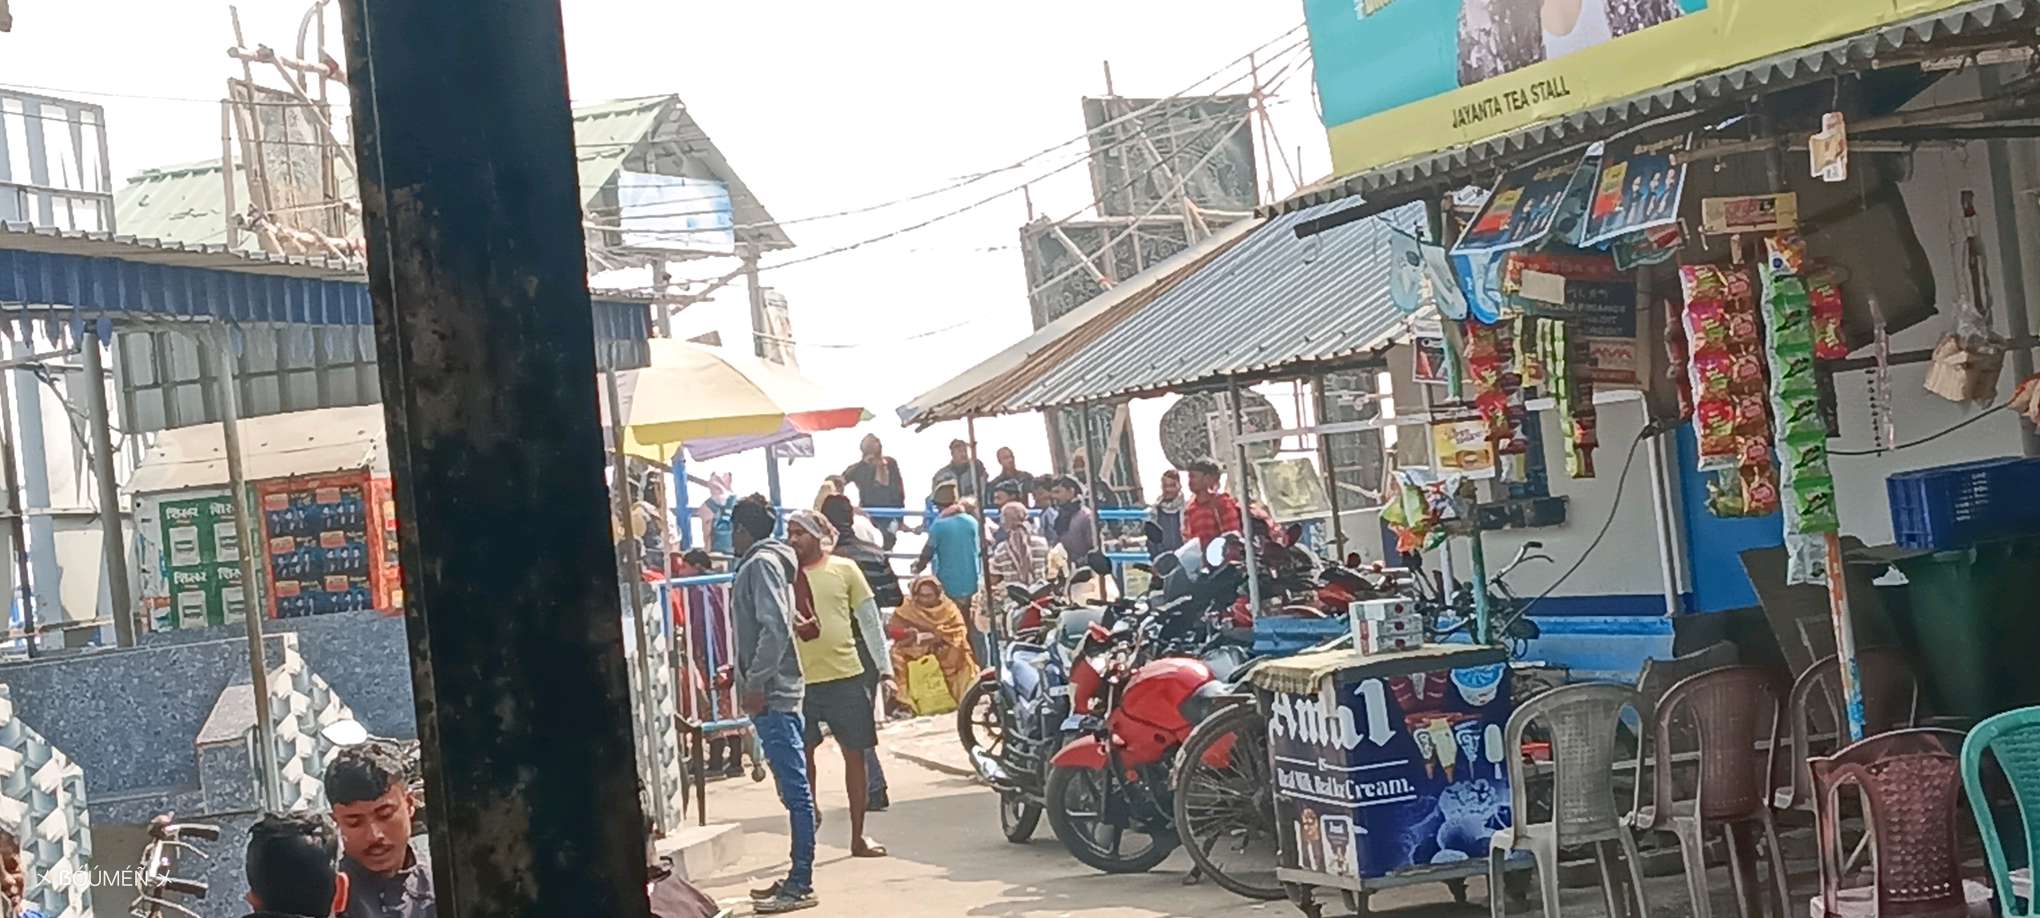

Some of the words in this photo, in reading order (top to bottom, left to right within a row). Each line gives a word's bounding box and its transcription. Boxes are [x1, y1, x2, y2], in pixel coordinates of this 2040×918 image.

[1452, 96, 1503, 128] JAYANTA
[1503, 88, 1530, 112] TEA
[1530, 75, 1571, 104] STALL
